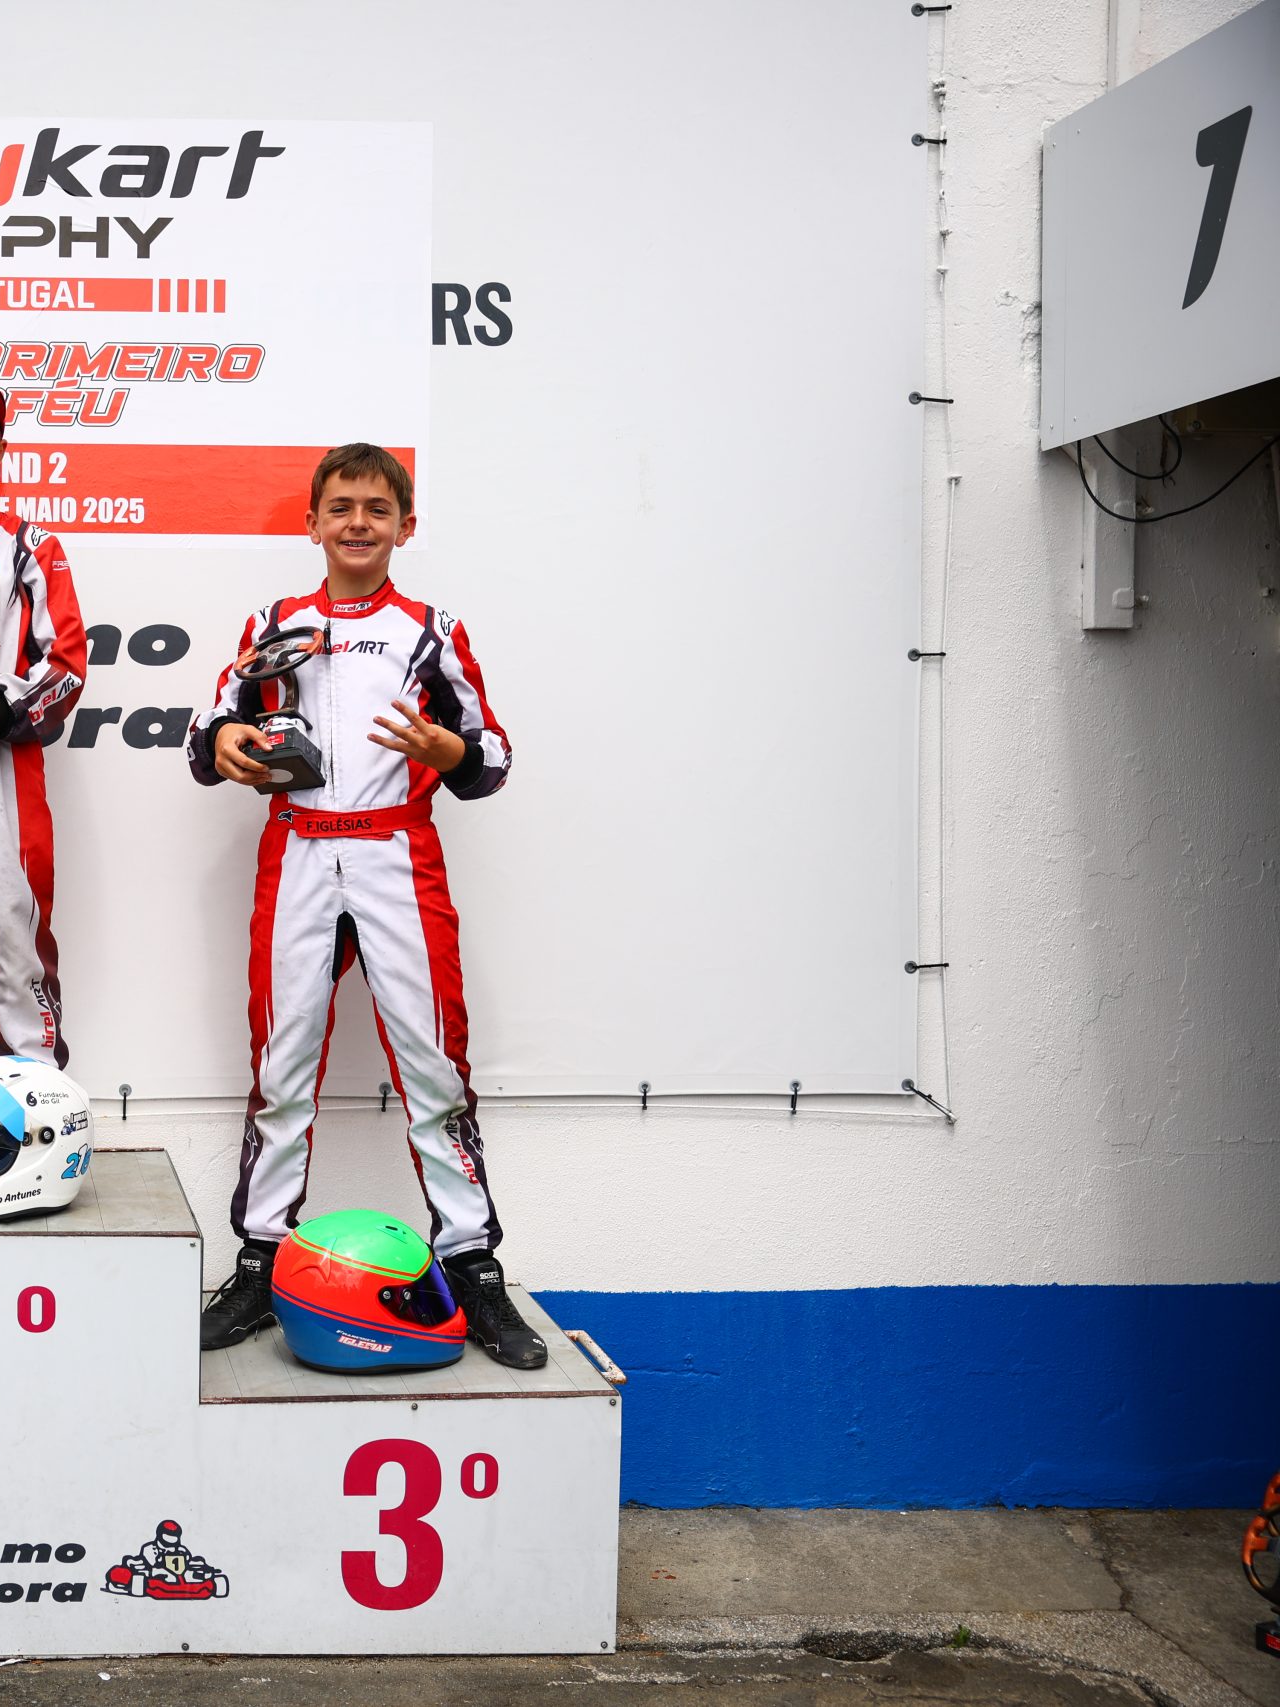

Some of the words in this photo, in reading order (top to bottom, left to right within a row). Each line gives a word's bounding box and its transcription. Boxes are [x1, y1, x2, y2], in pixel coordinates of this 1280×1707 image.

[1181, 104, 1253, 311] 1
[48, 452, 68, 484] 2
[15, 496, 77, 523] MAIO
[82, 497, 145, 524] 2025
[4, 1188, 42, 1203] Antunes
